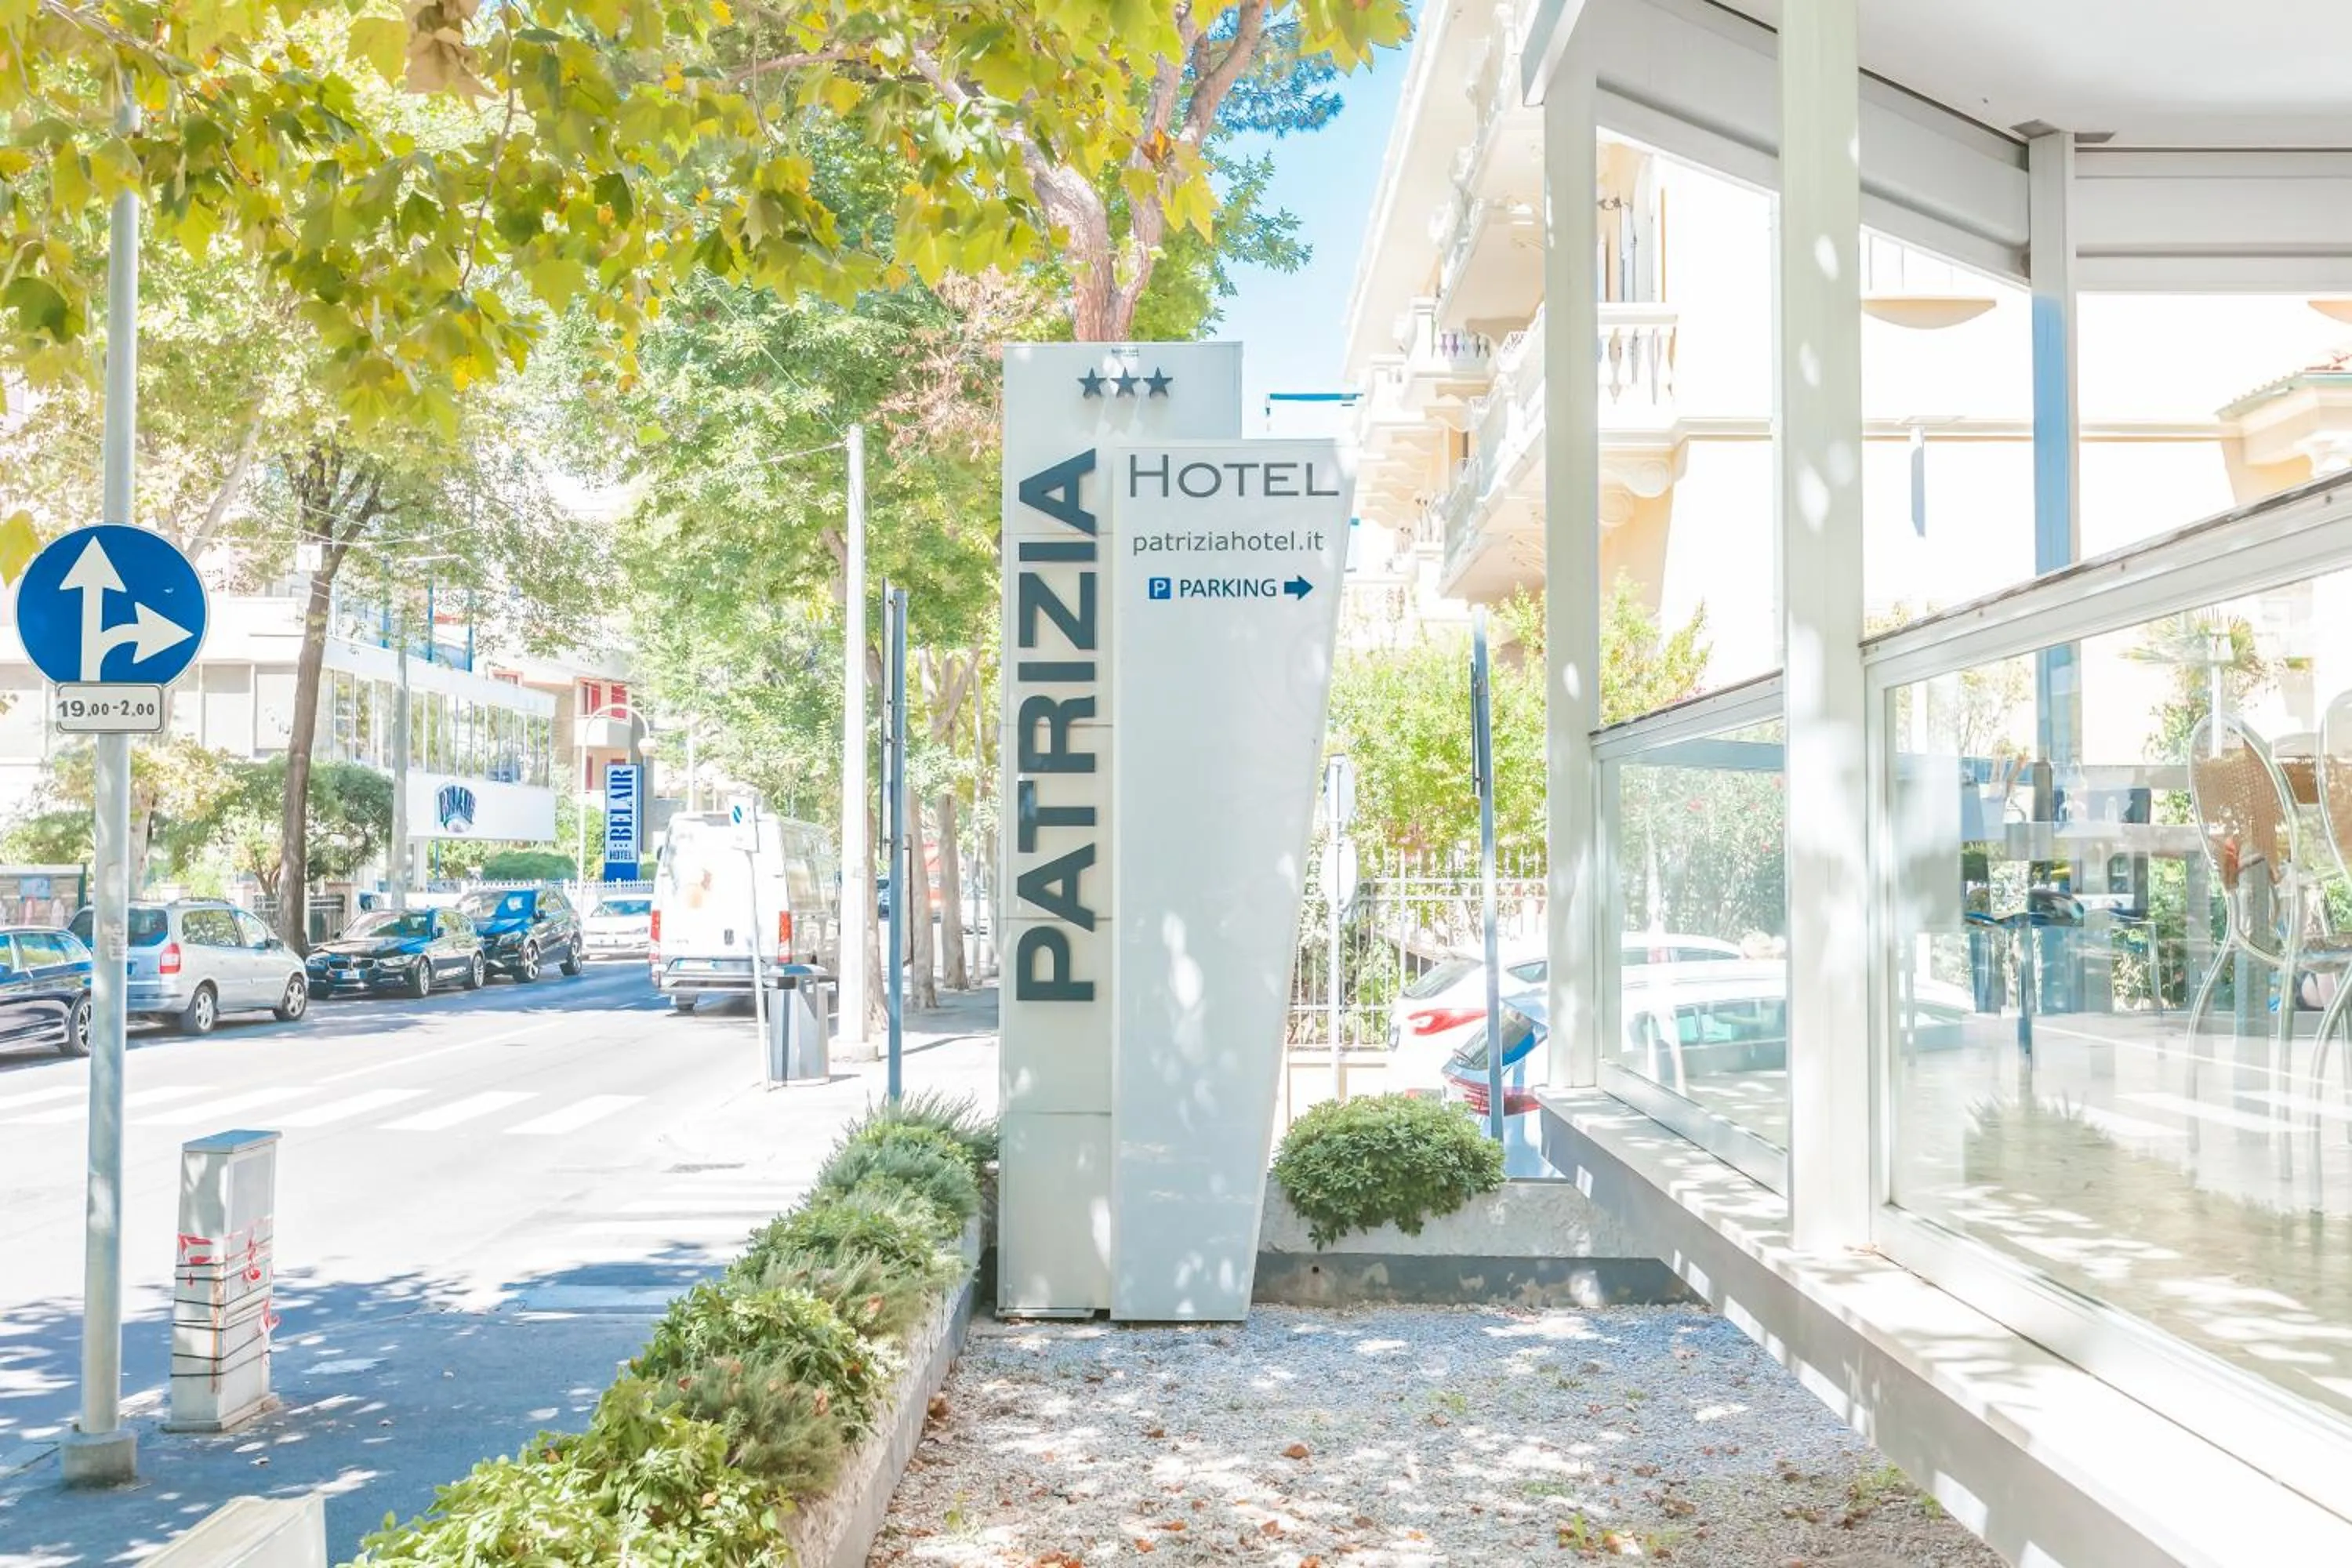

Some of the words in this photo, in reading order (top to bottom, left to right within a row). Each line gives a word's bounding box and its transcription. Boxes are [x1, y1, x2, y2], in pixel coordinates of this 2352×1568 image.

[1134, 531, 1323, 556] patriziahotel.it
[1180, 579, 1276, 597] PARKING
[57, 699, 154, 717] 19.00-2.00
[1016, 448, 1097, 1002] PATRIZIA
[609, 849, 633, 860] HOTEL
